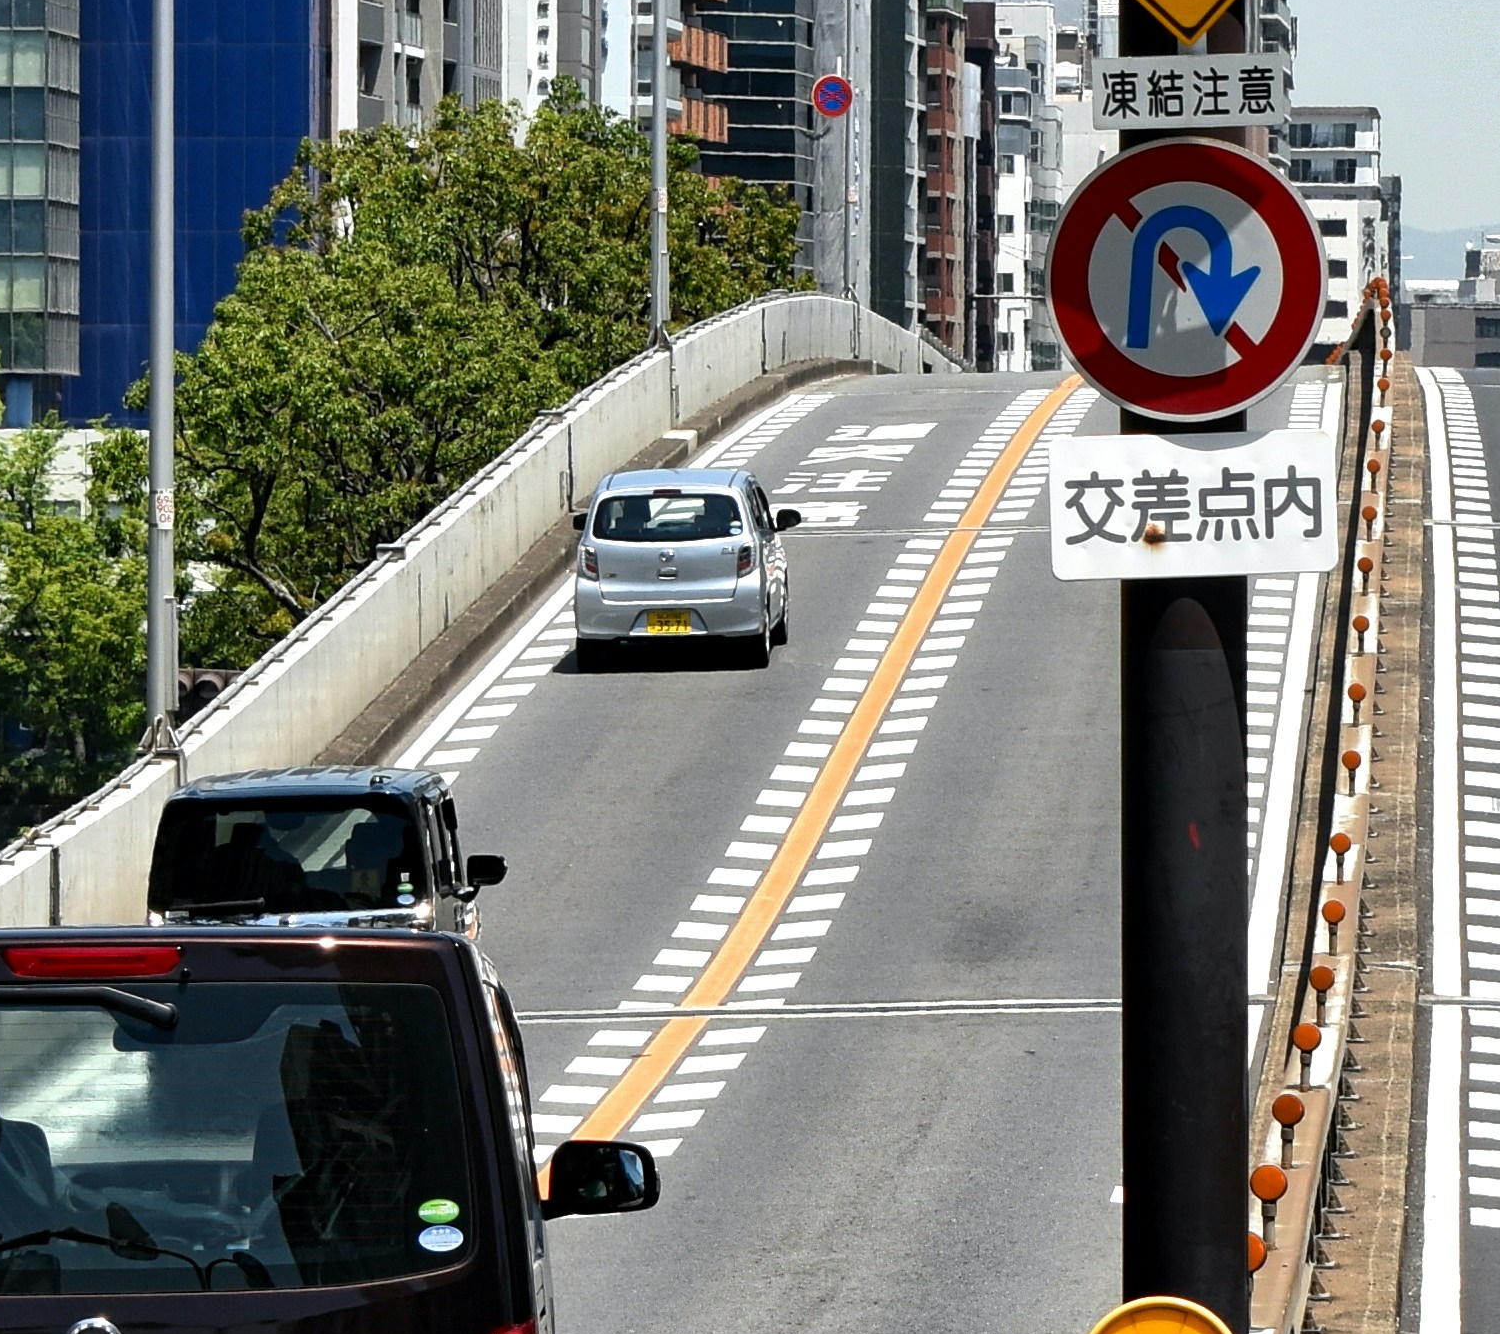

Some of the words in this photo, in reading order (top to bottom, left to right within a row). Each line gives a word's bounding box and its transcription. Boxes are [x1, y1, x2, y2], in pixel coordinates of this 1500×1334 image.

[1102, 65, 1276, 119] 凍結注意
[1064, 464, 1323, 546] 交差点内
